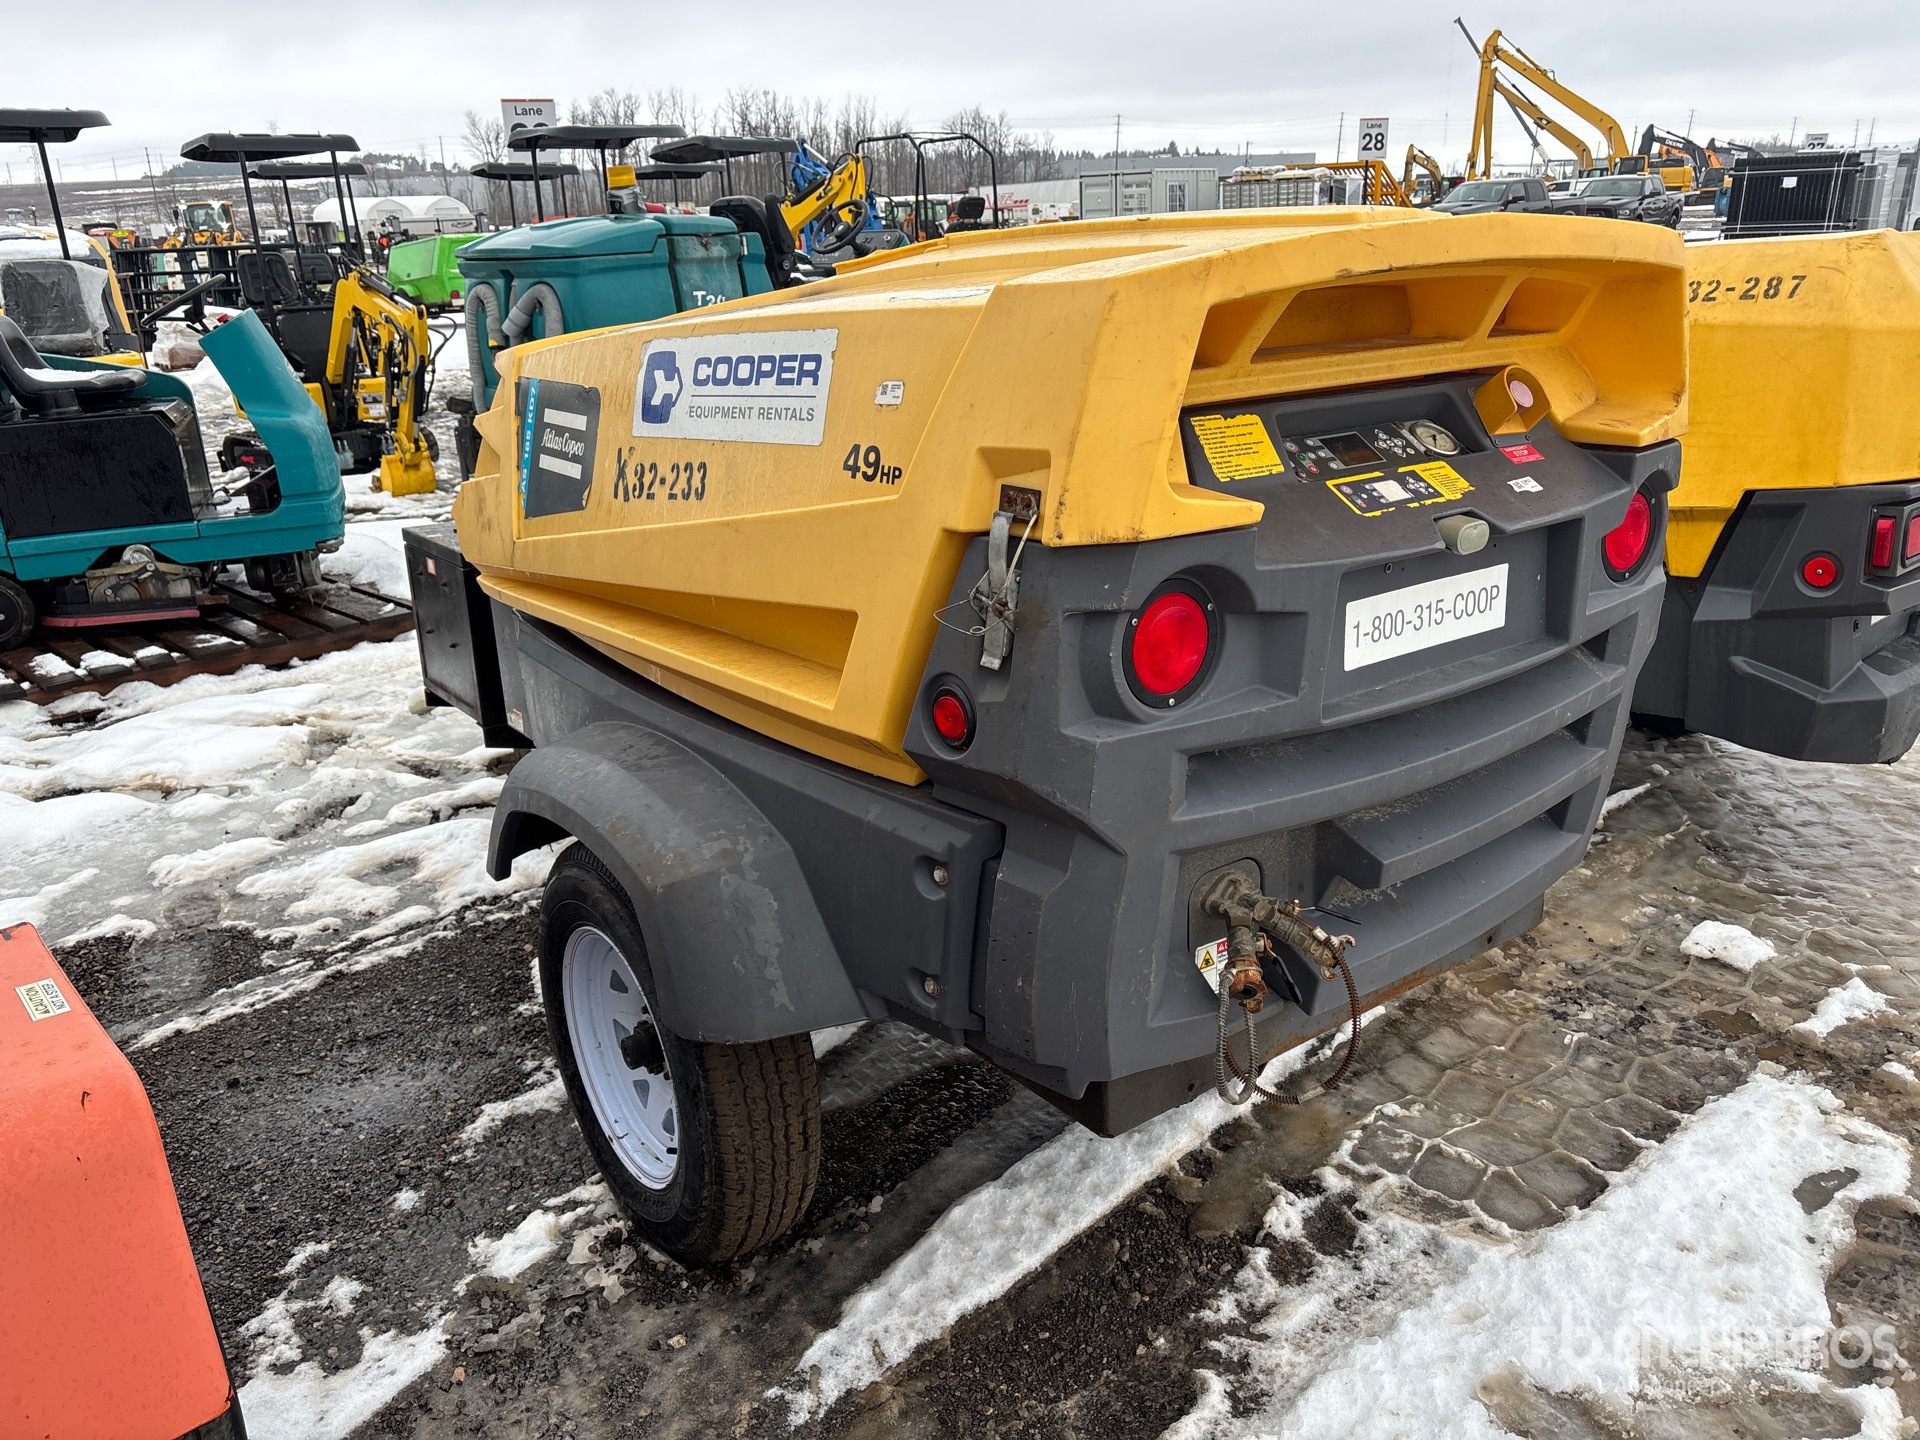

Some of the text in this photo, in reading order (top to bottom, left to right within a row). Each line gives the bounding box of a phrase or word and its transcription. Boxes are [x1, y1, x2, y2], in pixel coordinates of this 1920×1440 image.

[513, 105, 543, 116] Lane
[1361, 132, 1385, 151] 28
[692, 353, 823, 387] COOPER
[688, 405, 815, 422] EQUIPMENT RENTALS
[541, 428, 585, 458] Atlas Copco
[1352, 584, 1500, 648] 1-800-315-COOP
[42, 982, 59, 996] STEP
[24, 986, 48, 1013] CAUTION
[51, 998, 68, 1011] NOT
